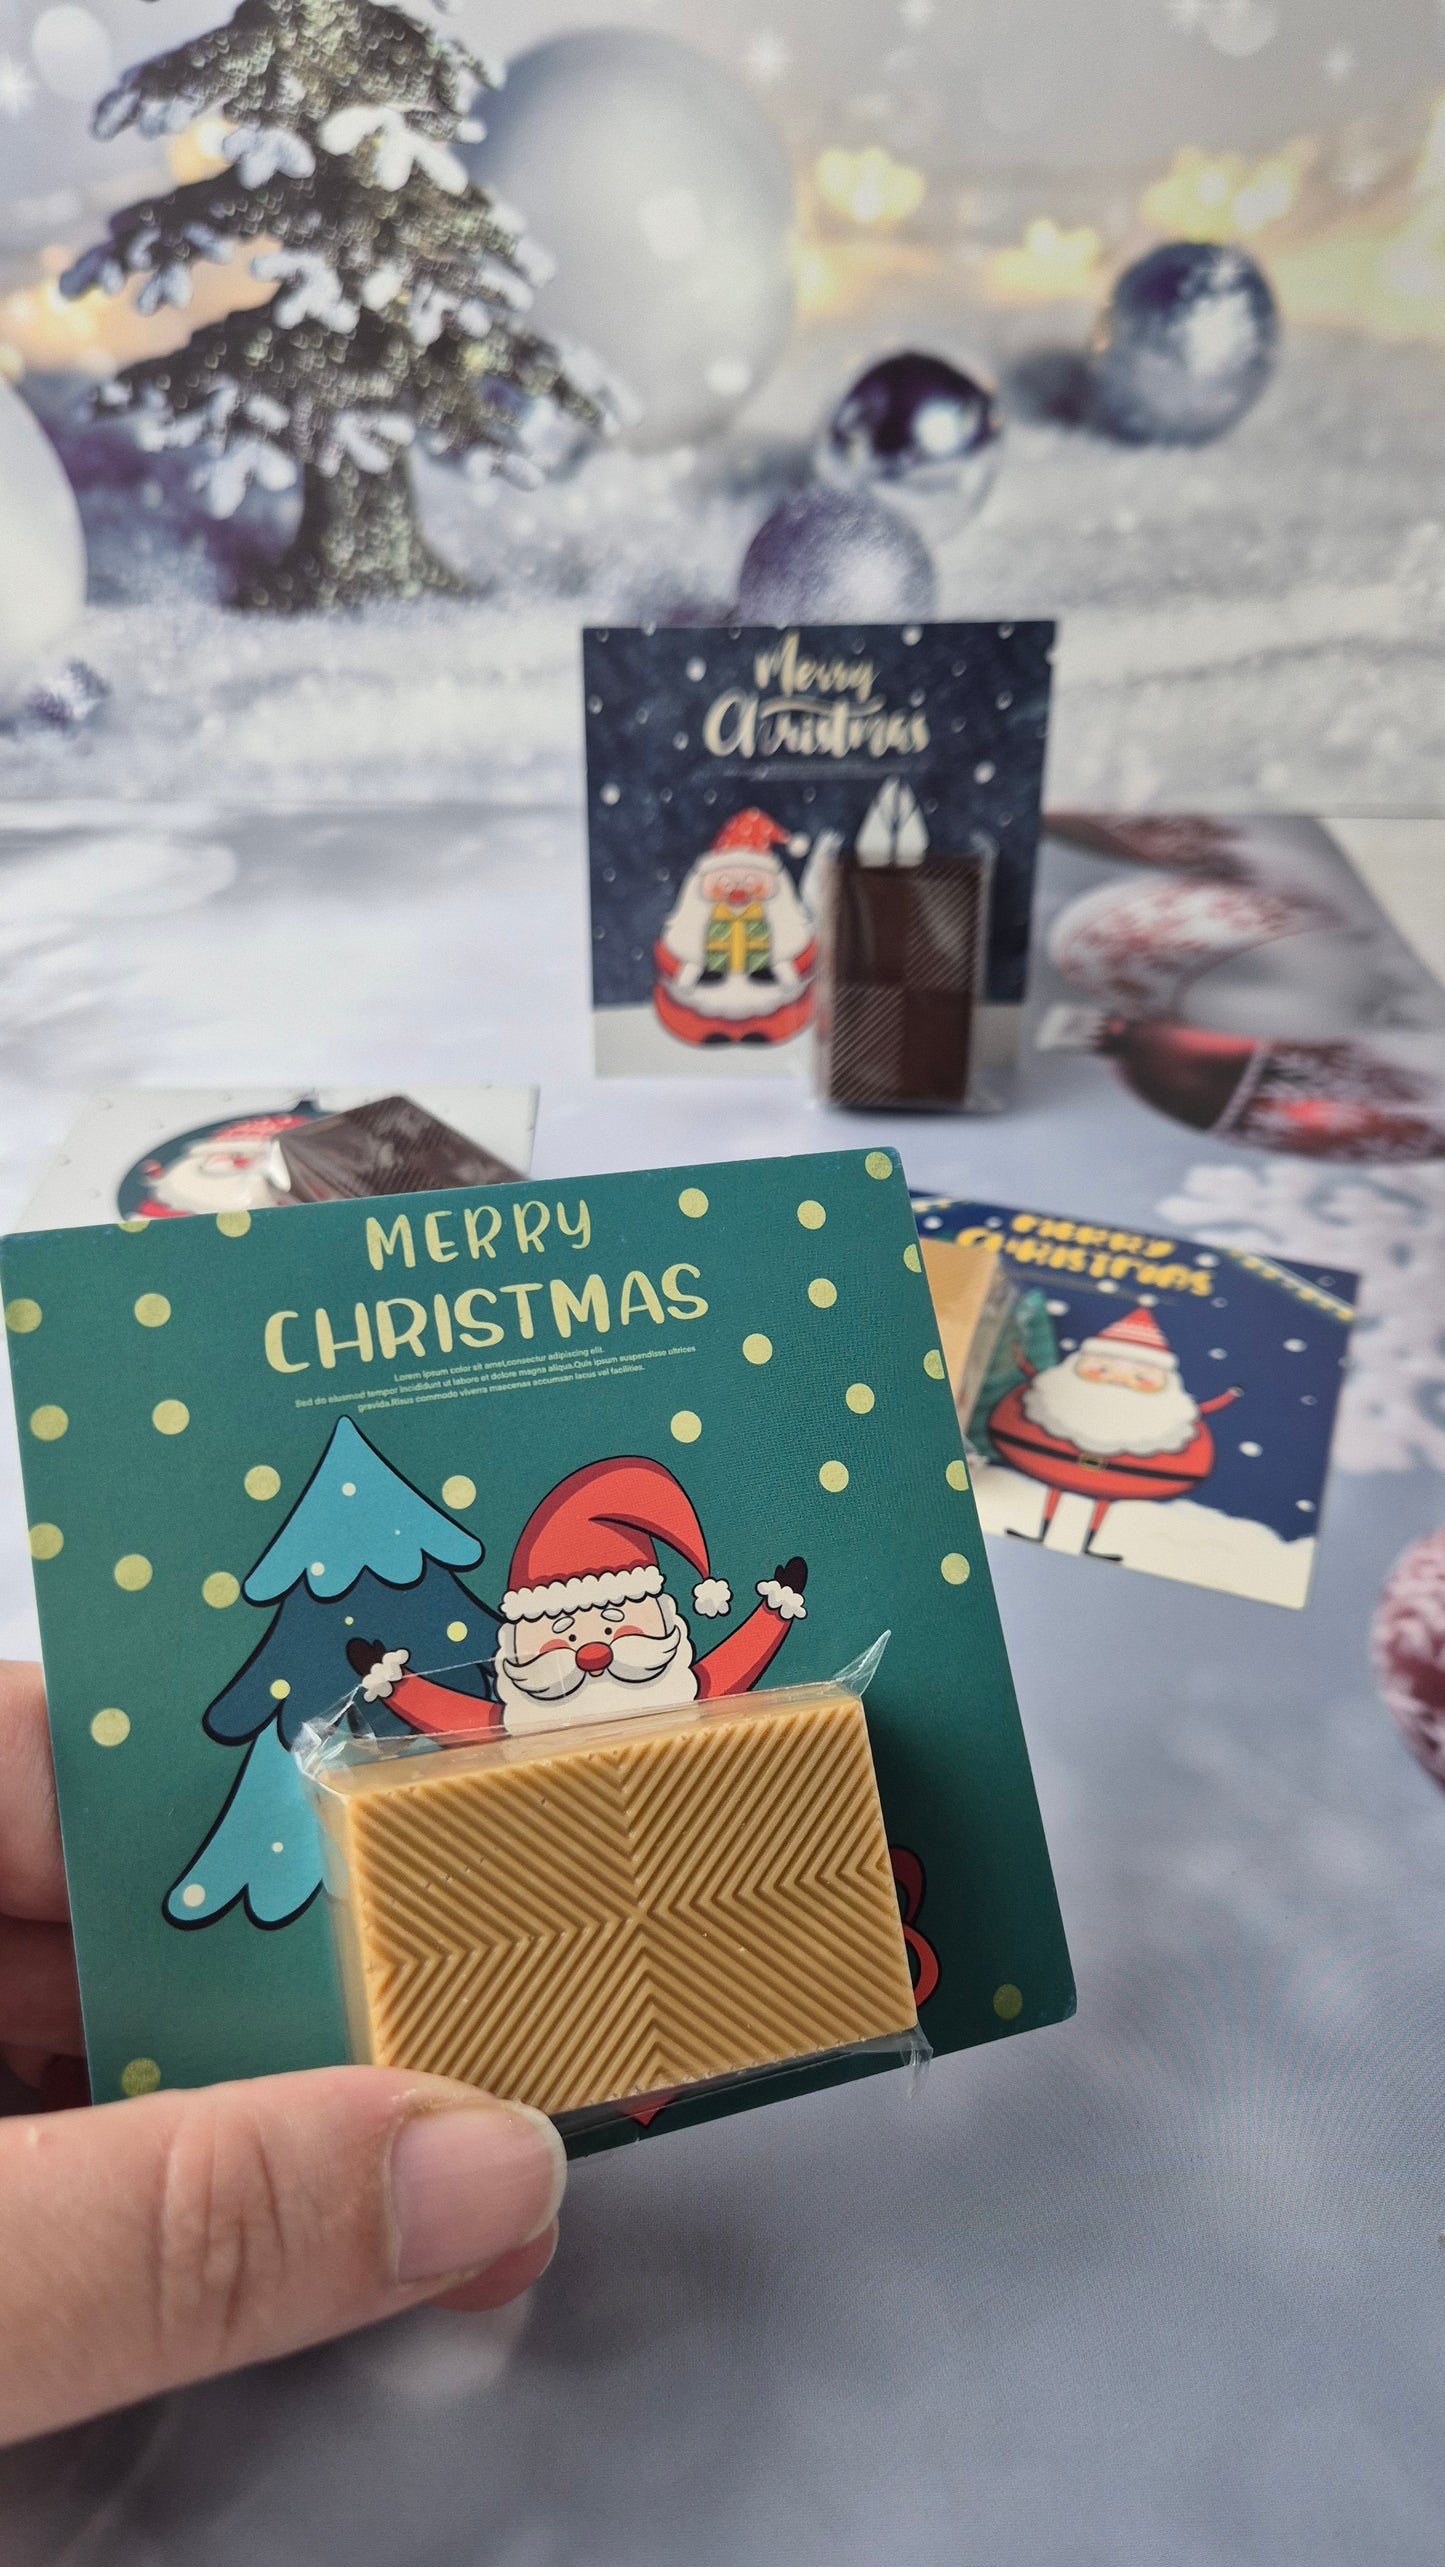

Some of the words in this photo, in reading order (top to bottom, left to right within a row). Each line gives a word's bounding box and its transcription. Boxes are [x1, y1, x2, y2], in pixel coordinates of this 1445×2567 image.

[754, 632, 881, 704] Merry
[702, 688, 931, 759] Christmas
[366, 1199, 592, 1271] MERRY
[264, 1262, 709, 1374] CHRISTMAS
[314, 1397, 327, 1406] do
[367, 1387, 398, 1398] tempor
[453, 1376, 479, 1386] labore
[481, 1373, 489, 1381] et
[491, 1370, 517, 1380] dolore
[518, 1366, 546, 1377] magna
[594, 1356, 618, 1367] ipsum
[619, 1349, 667, 1362] suspendisse
[668, 1345, 696, 1355] ultrices
[394, 1372, 421, 1382] Lorem
[422, 1368, 448, 1379] ipsum
[473, 1362, 482, 1371] sit
[548, 1348, 589, 1361] adipiscing
[415, 1391, 459, 1402] commodo
[460, 1386, 488, 1397] viverra
[489, 1380, 531, 1392] maecenas
[532, 1374, 574, 1386] accumsan
[575, 1371, 596, 1380] lacus
[598, 1368, 609, 1377] vel
